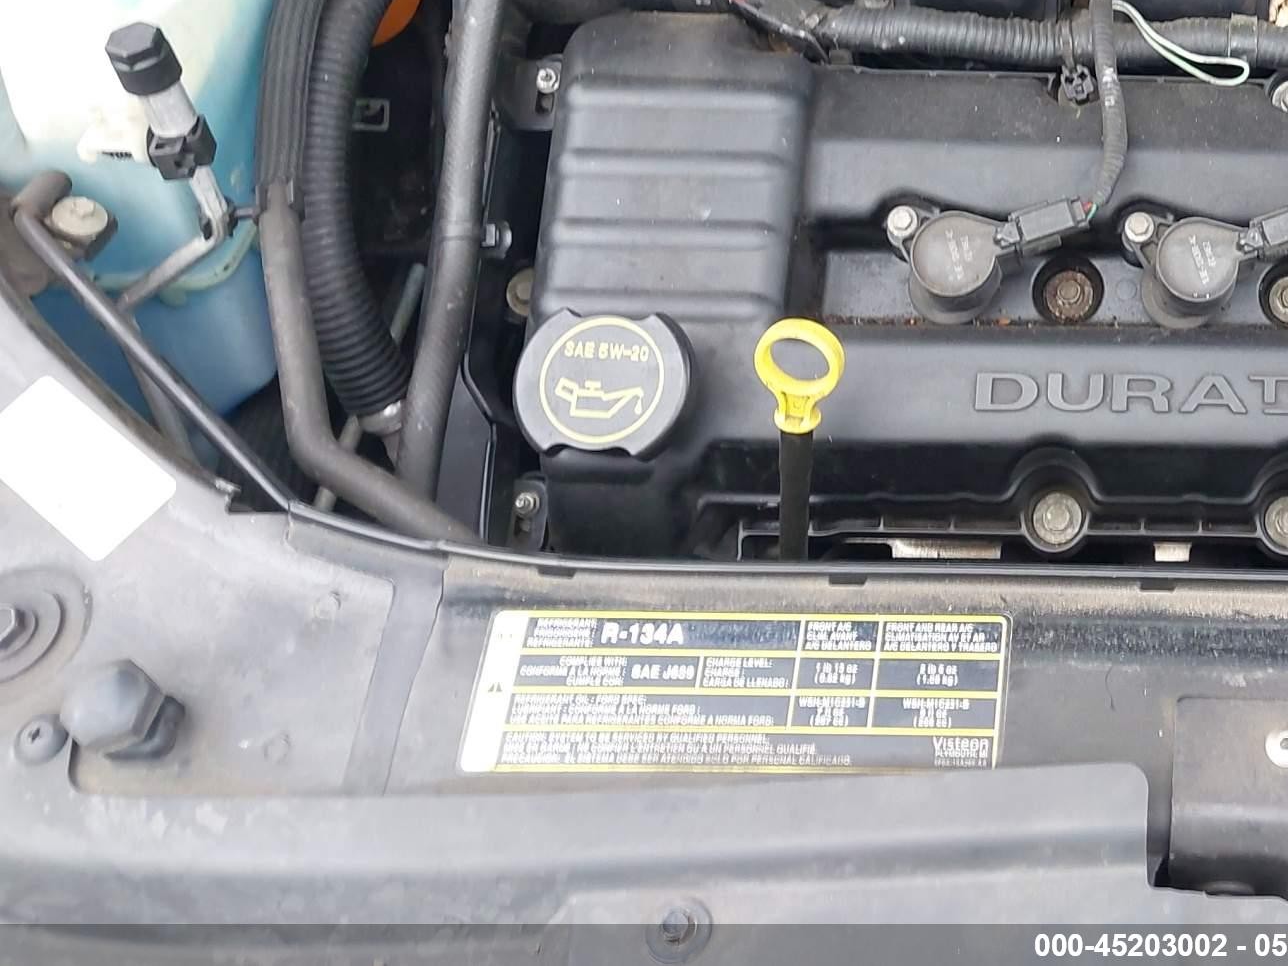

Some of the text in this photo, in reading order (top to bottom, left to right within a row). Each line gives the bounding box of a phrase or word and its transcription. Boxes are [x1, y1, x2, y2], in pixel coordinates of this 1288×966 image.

[564, 340, 649, 363] SAE 5W-20
[600, 621, 684, 646] R-134A
[630, 664, 661, 680] SAE
[932, 736, 989, 752] Visteon
